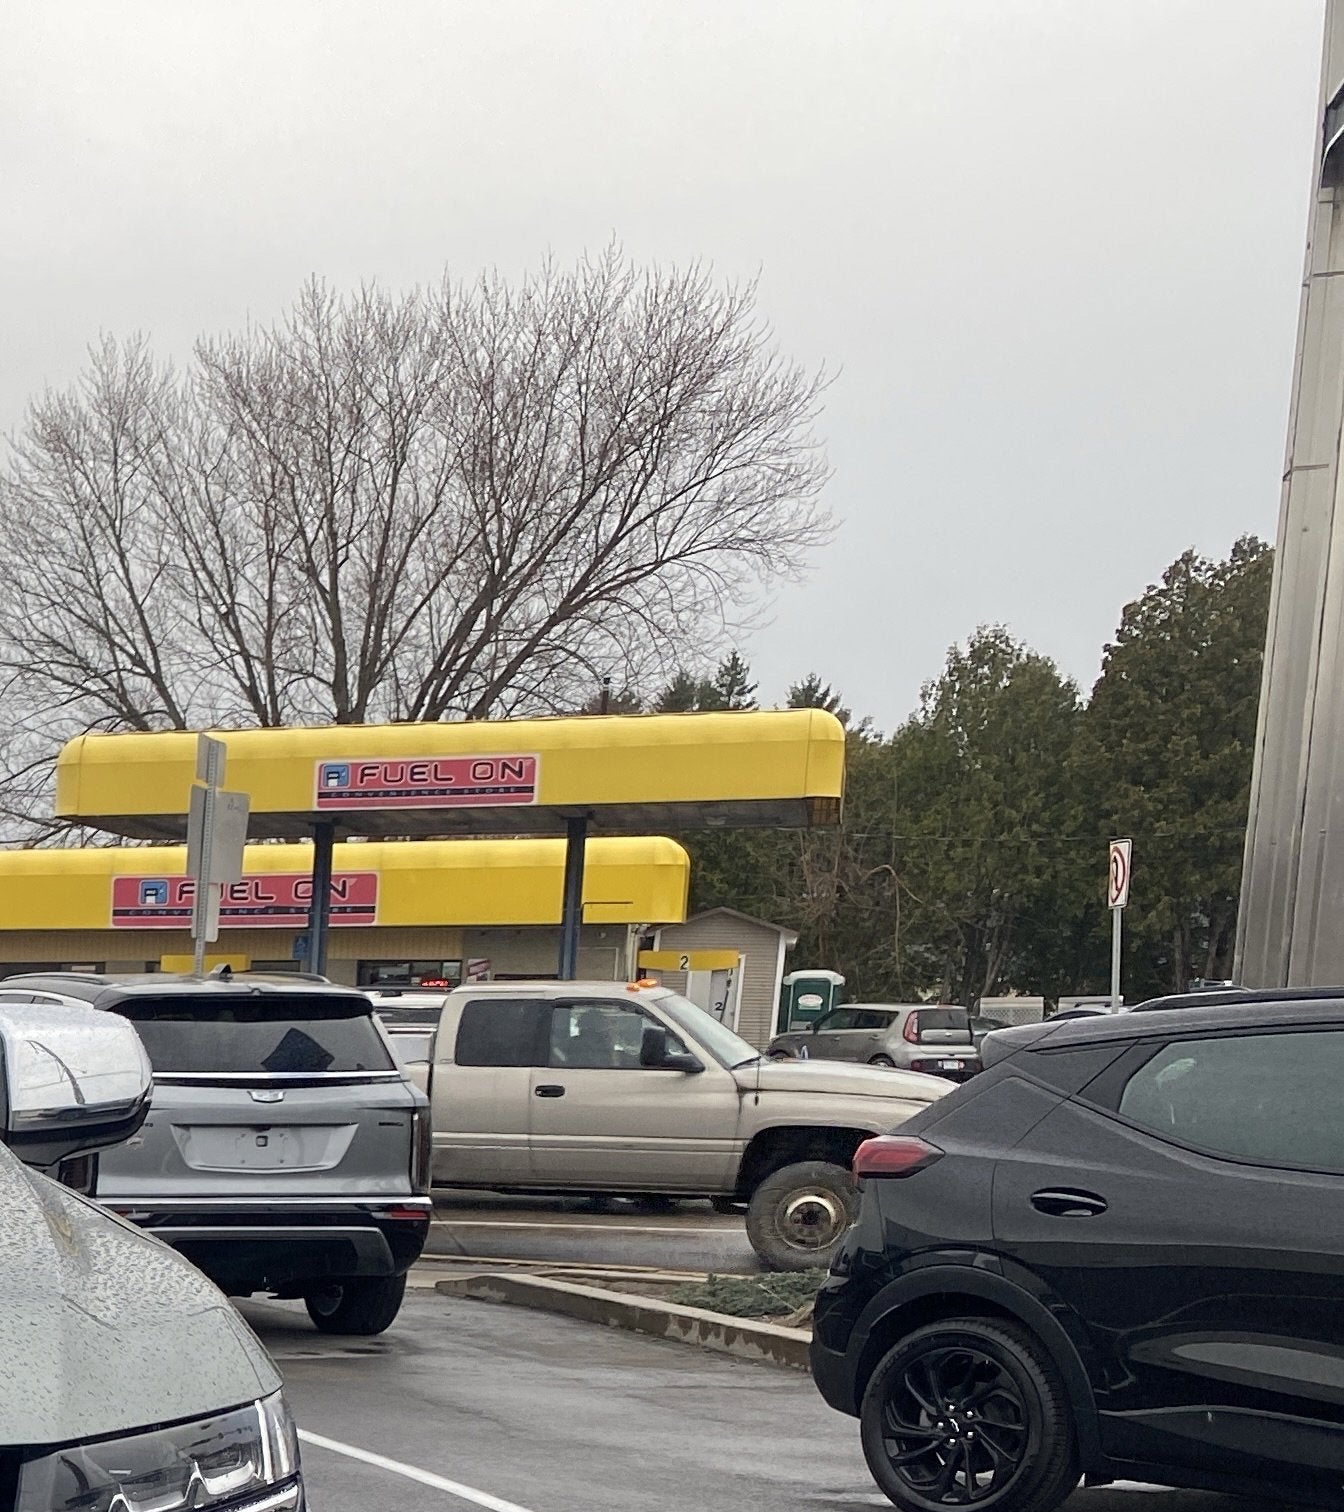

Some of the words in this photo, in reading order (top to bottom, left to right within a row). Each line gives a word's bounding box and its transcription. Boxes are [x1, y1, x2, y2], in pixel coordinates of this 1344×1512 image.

[359, 763, 454, 784] FUEL
[472, 759, 524, 781] ON
[330, 788, 453, 798] CONVENIENCE
[463, 786, 516, 795] STORE
[680, 955, 689, 970] 2
[714, 1002, 724, 1011] 2
